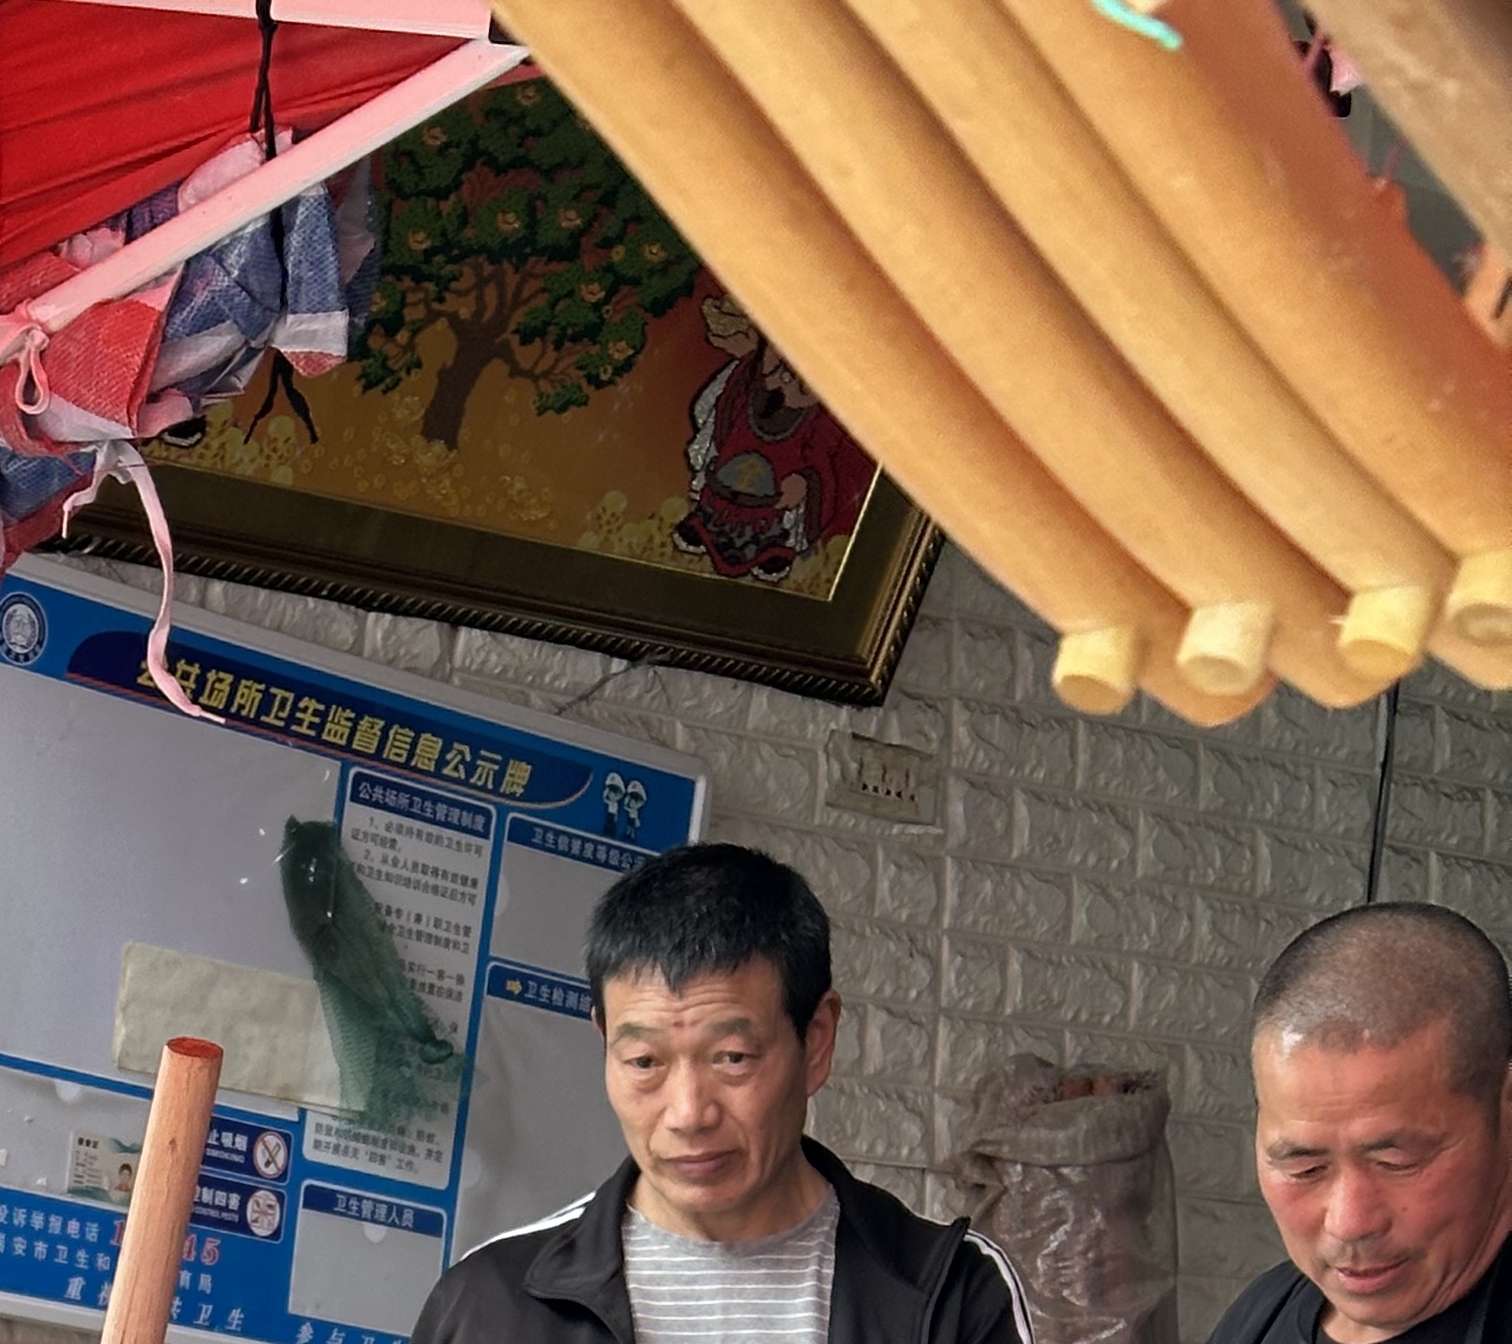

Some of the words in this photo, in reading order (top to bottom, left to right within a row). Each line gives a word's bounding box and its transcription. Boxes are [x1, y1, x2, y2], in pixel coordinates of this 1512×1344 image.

[358, 781, 486, 833] 公共场所卫生管理制度
[333, 1193, 415, 1229] 卫生管理人员
